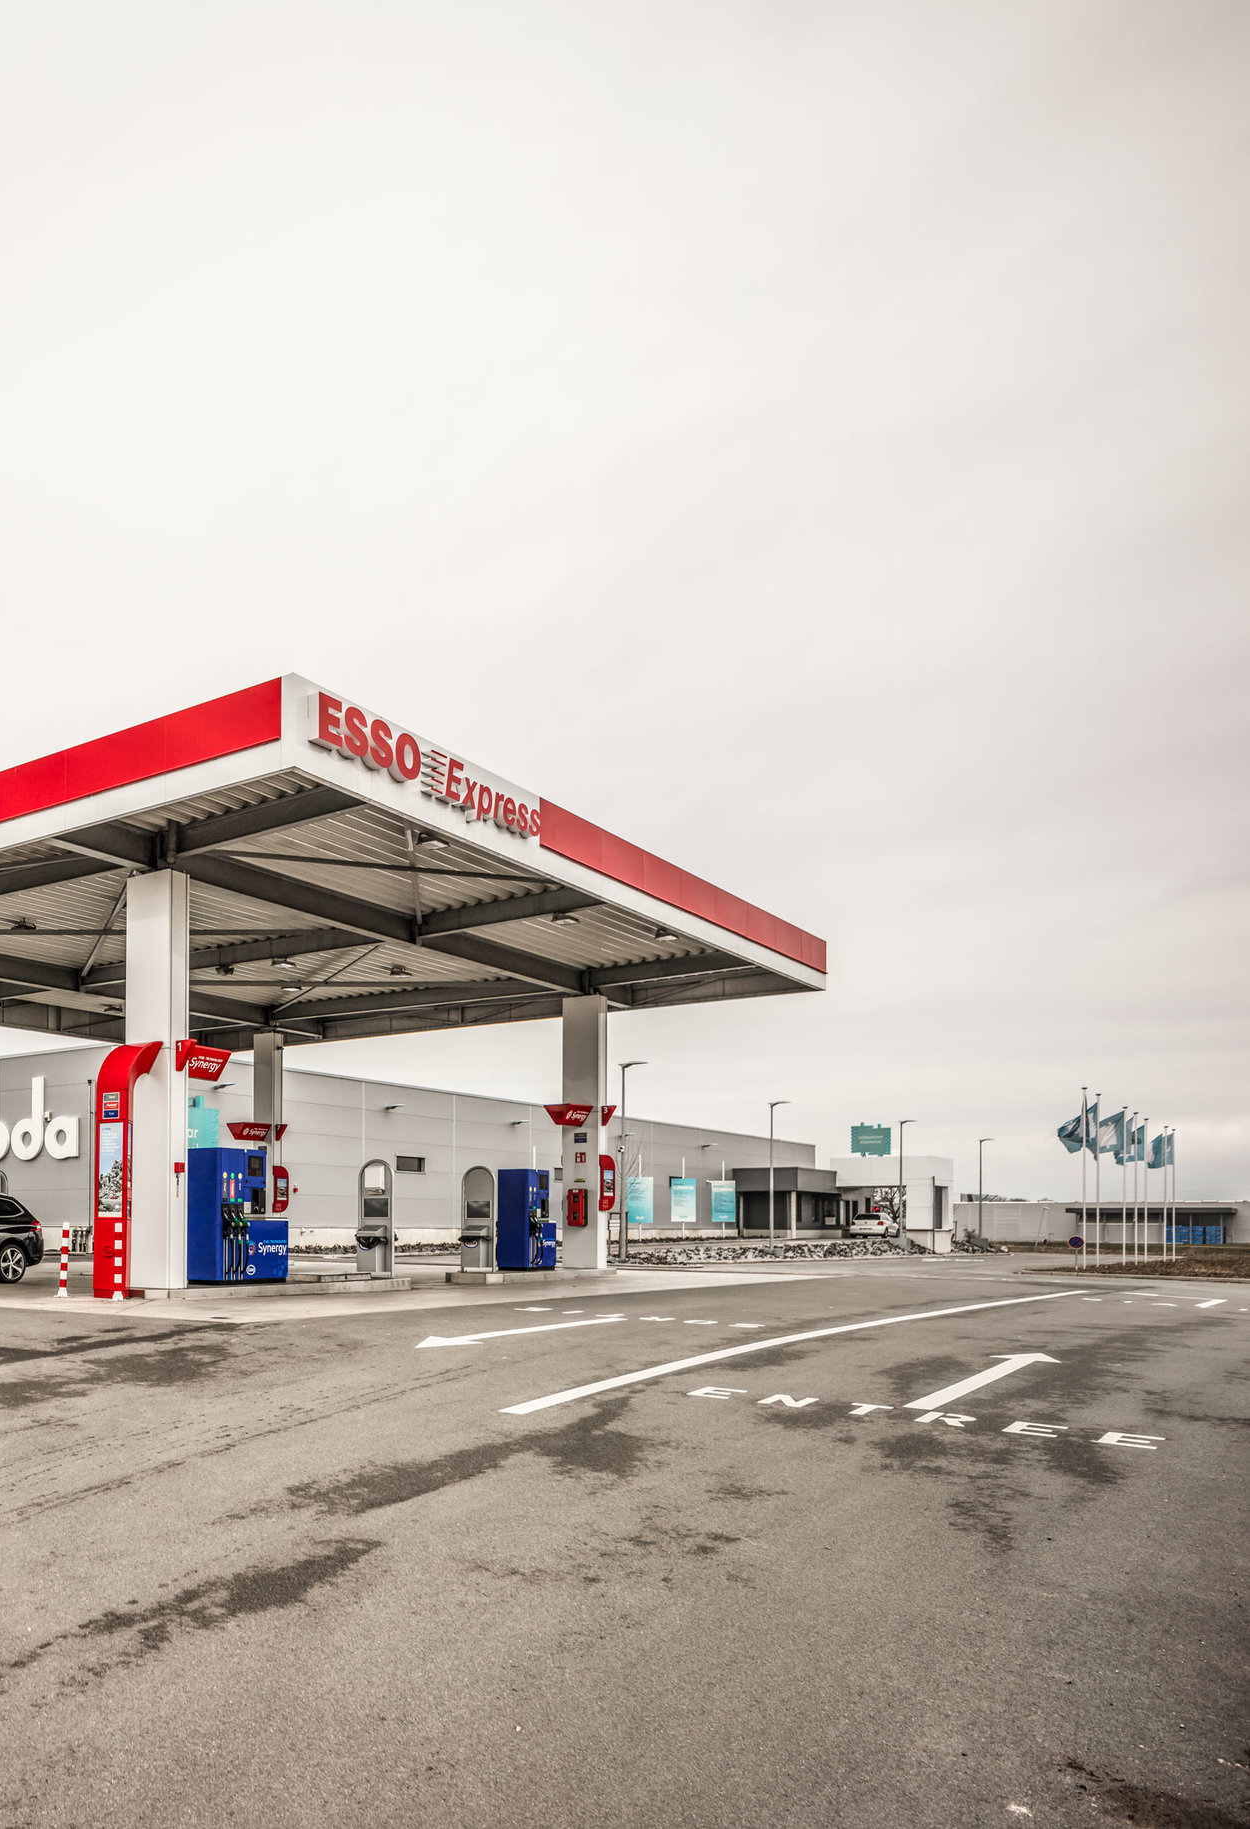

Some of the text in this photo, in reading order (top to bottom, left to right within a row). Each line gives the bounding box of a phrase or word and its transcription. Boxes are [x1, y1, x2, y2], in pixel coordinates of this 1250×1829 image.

[318, 691, 421, 781] ESSO
[445, 757, 541, 837] Express
[177, 1042, 182, 1052] 1
[189, 1057, 221, 1073] Synergy
[603, 1106, 608, 1114] 3
[187, 1128, 198, 1139] ar
[258, 1242, 287, 1256] Synergy
[687, 1386, 1166, 1450] ENTREE
